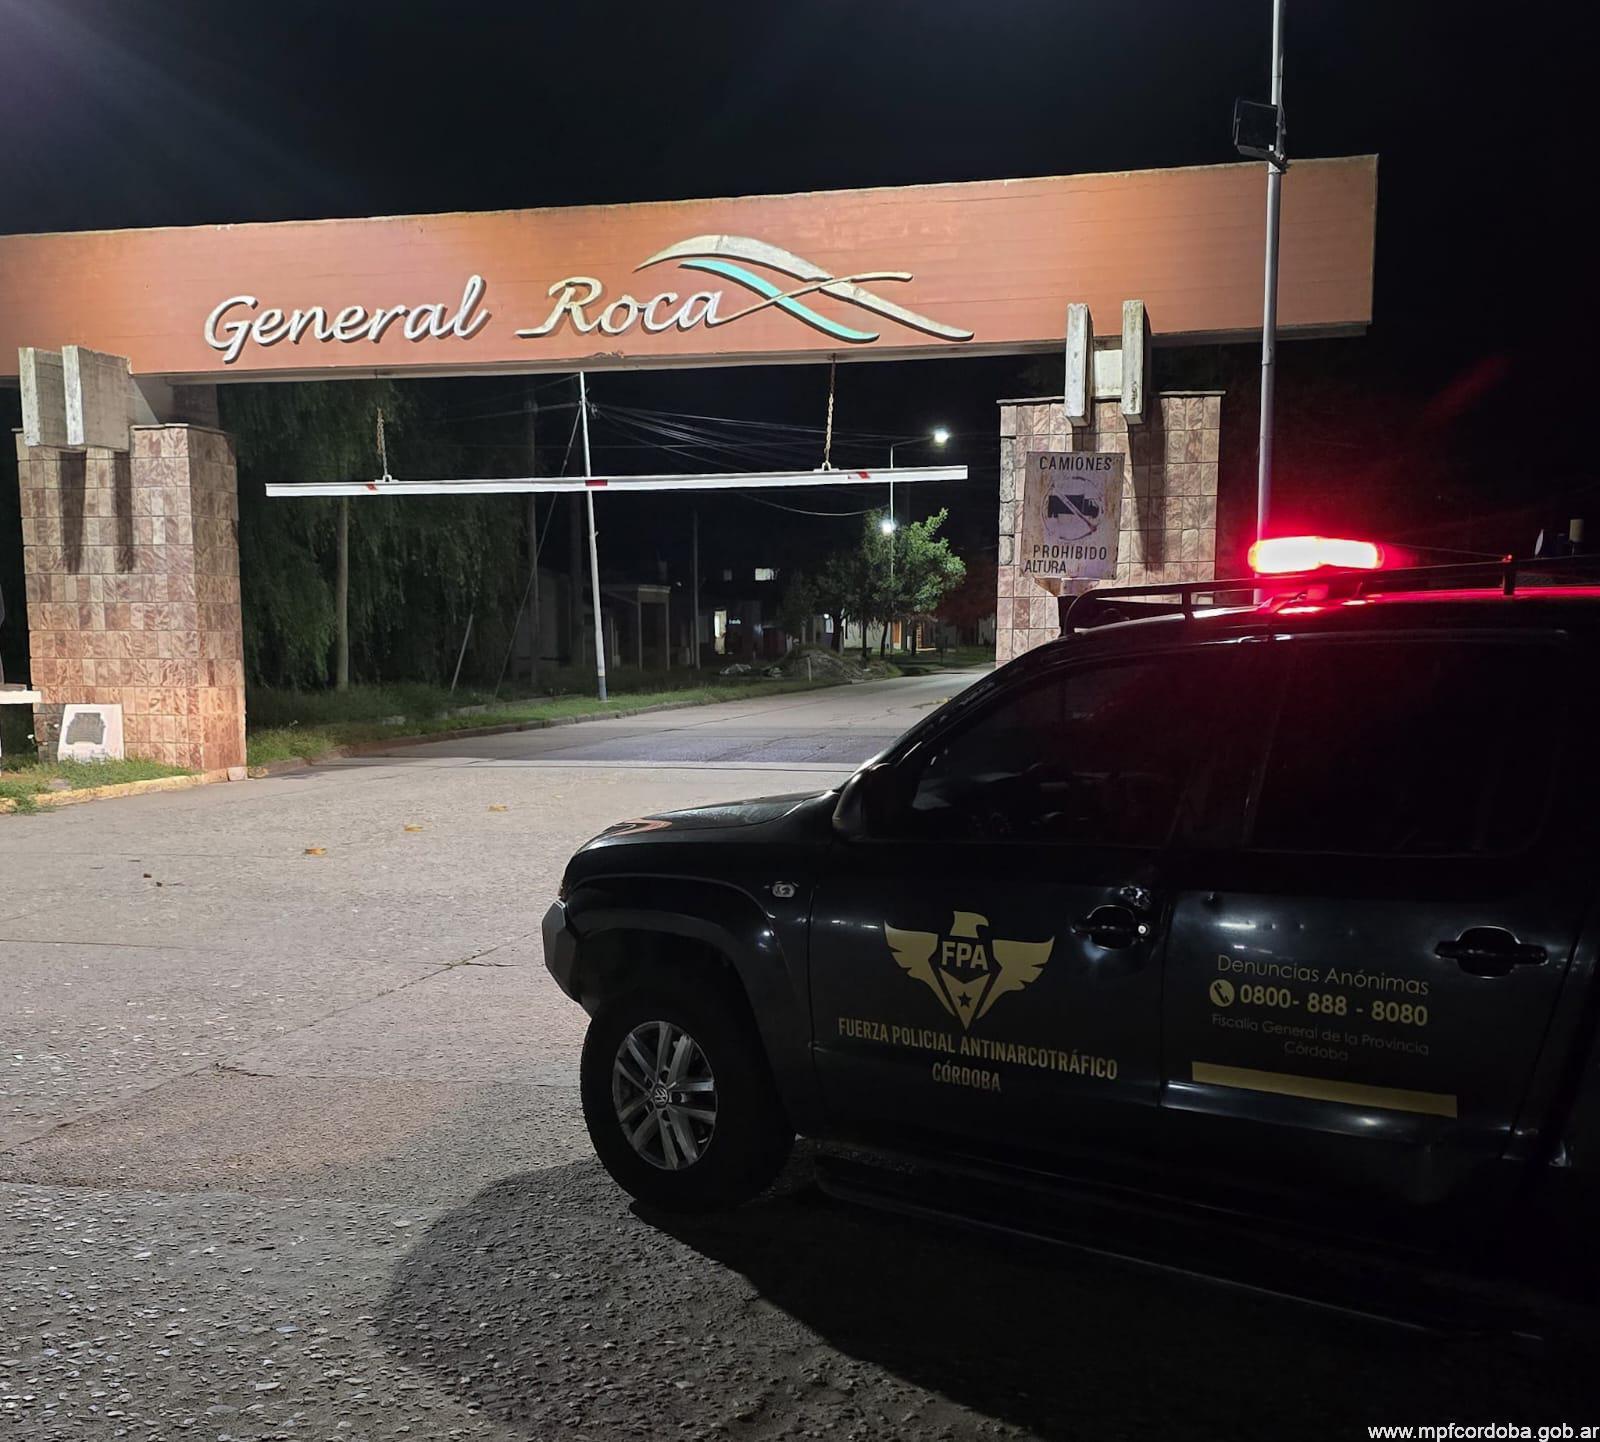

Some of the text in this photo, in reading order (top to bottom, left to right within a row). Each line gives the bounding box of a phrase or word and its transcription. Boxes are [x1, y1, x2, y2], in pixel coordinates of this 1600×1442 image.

[204, 274, 724, 363] General Roca
[1040, 456, 1112, 471] CAMIONES
[1025, 560, 1067, 574] ALTURA
[1033, 545, 1107, 560] PROHIBIDO
[941, 940, 989, 971] FPA
[1217, 954, 1429, 996] Denuncias Anónimas
[1306, 992, 1347, 1017] 888
[1371, 1000, 1429, 1027] 8080
[838, 1017, 1119, 1080] FUERZA POLICIAL ANTINARCOTRÁFICO
[1262, 1020, 1318, 1041] General
[1322, 1028, 1341, 1042] de
[1344, 1032, 1358, 1046] la
[1362, 1034, 1429, 1056] Provincia
[931, 1060, 1001, 1093] CÓRDOBA
